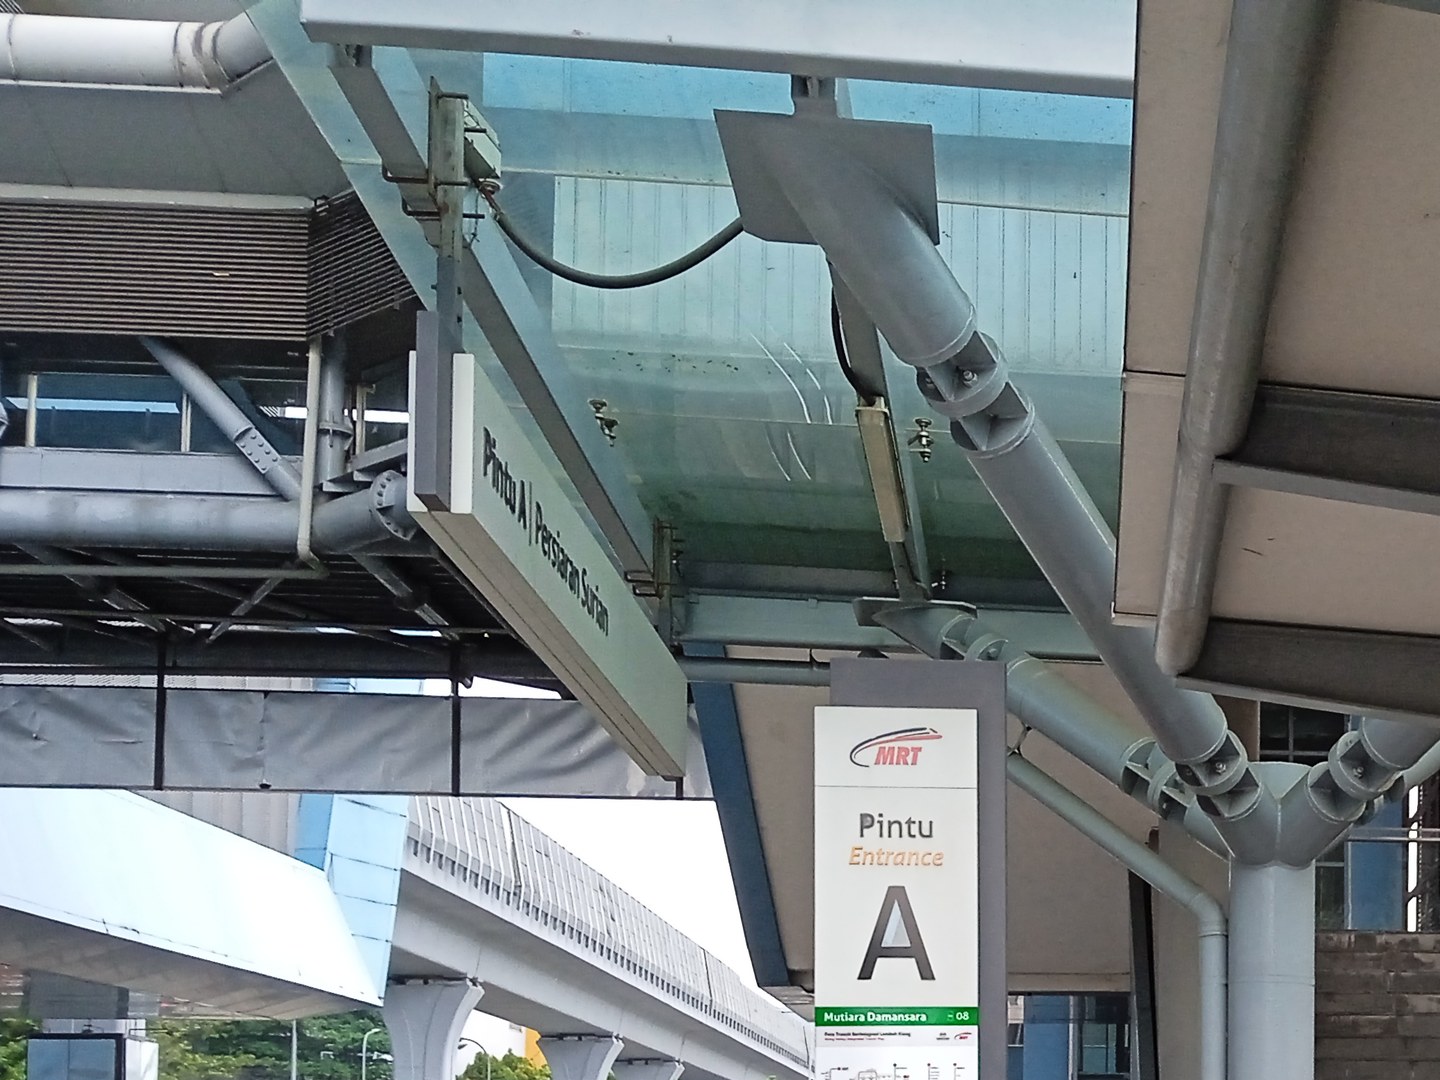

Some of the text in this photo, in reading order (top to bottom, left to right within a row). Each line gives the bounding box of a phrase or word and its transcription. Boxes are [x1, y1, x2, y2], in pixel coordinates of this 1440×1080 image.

[483, 426, 609, 637] Pintu A Persiaran Surian
[873, 746, 923, 766] MRT
[859, 812, 934, 839] Pintu
[849, 846, 944, 867] Entrance
[857, 885, 936, 981] A
[823, 1011, 866, 1022] Mutiara
[866, 1011, 927, 1022] Damansara
[955, 1011, 970, 1021] 08
